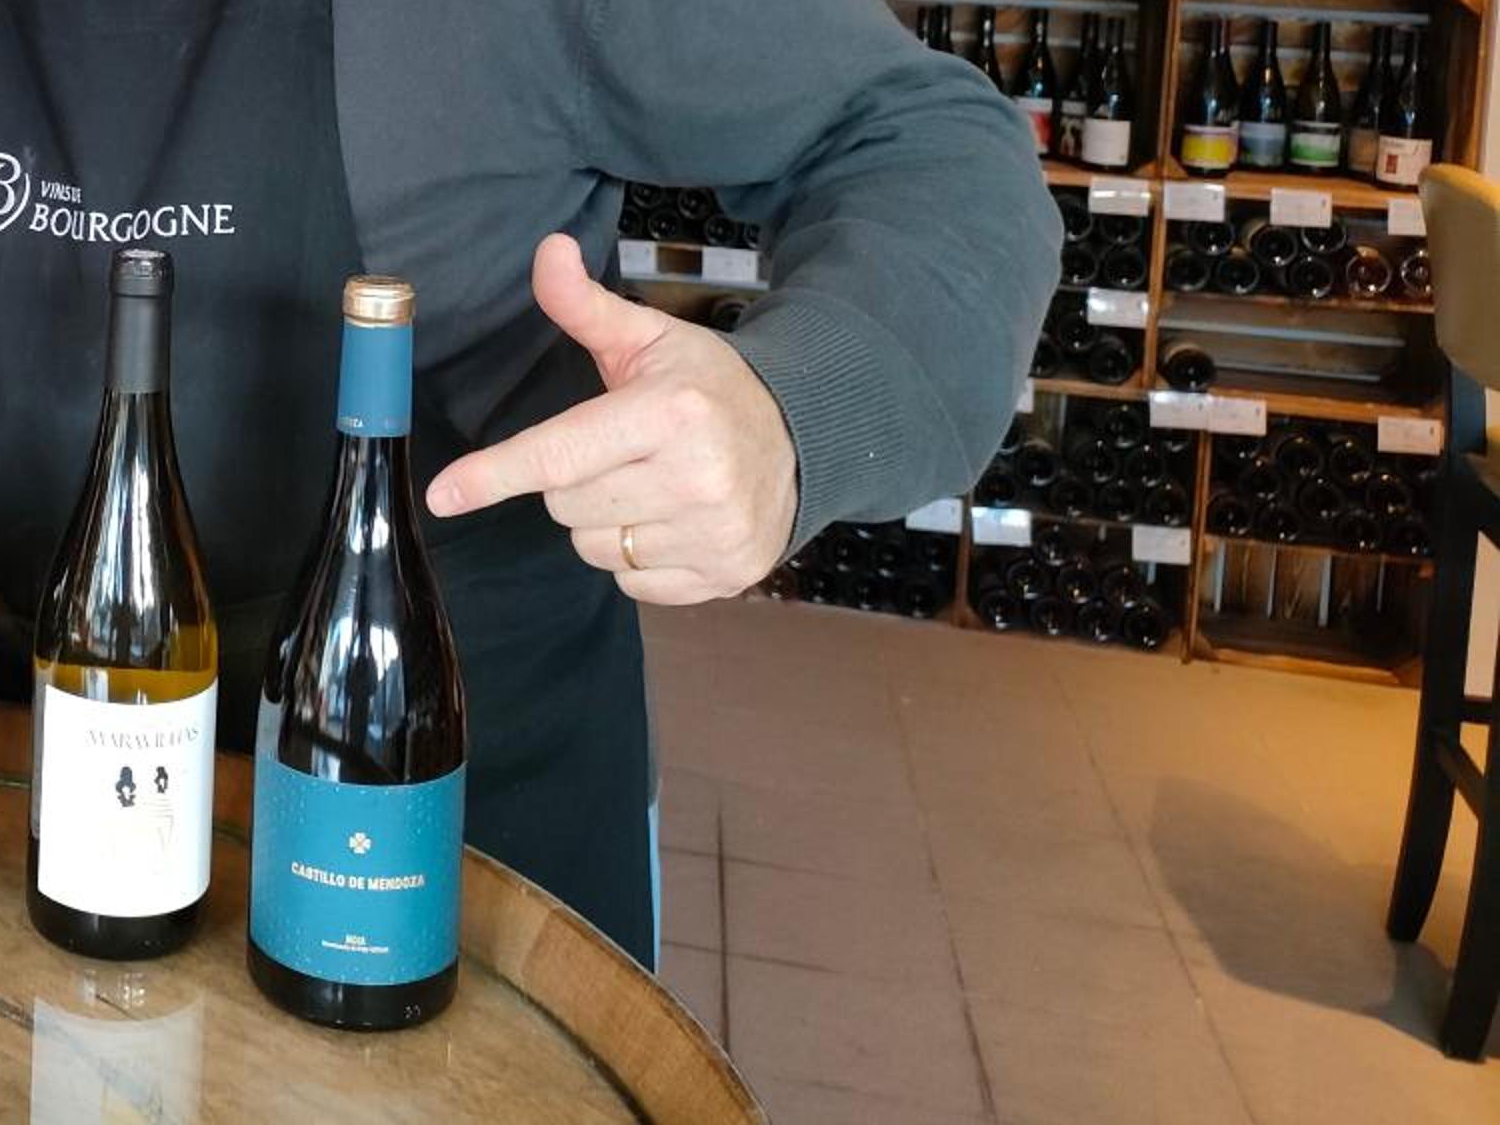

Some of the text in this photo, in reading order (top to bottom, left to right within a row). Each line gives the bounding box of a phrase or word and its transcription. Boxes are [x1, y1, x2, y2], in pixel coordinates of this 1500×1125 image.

[41, 179, 71, 202] VINS
[29, 203, 236, 243] BOURGOGNE
[290, 861, 426, 891] CASTILLO DE MENDOZA
